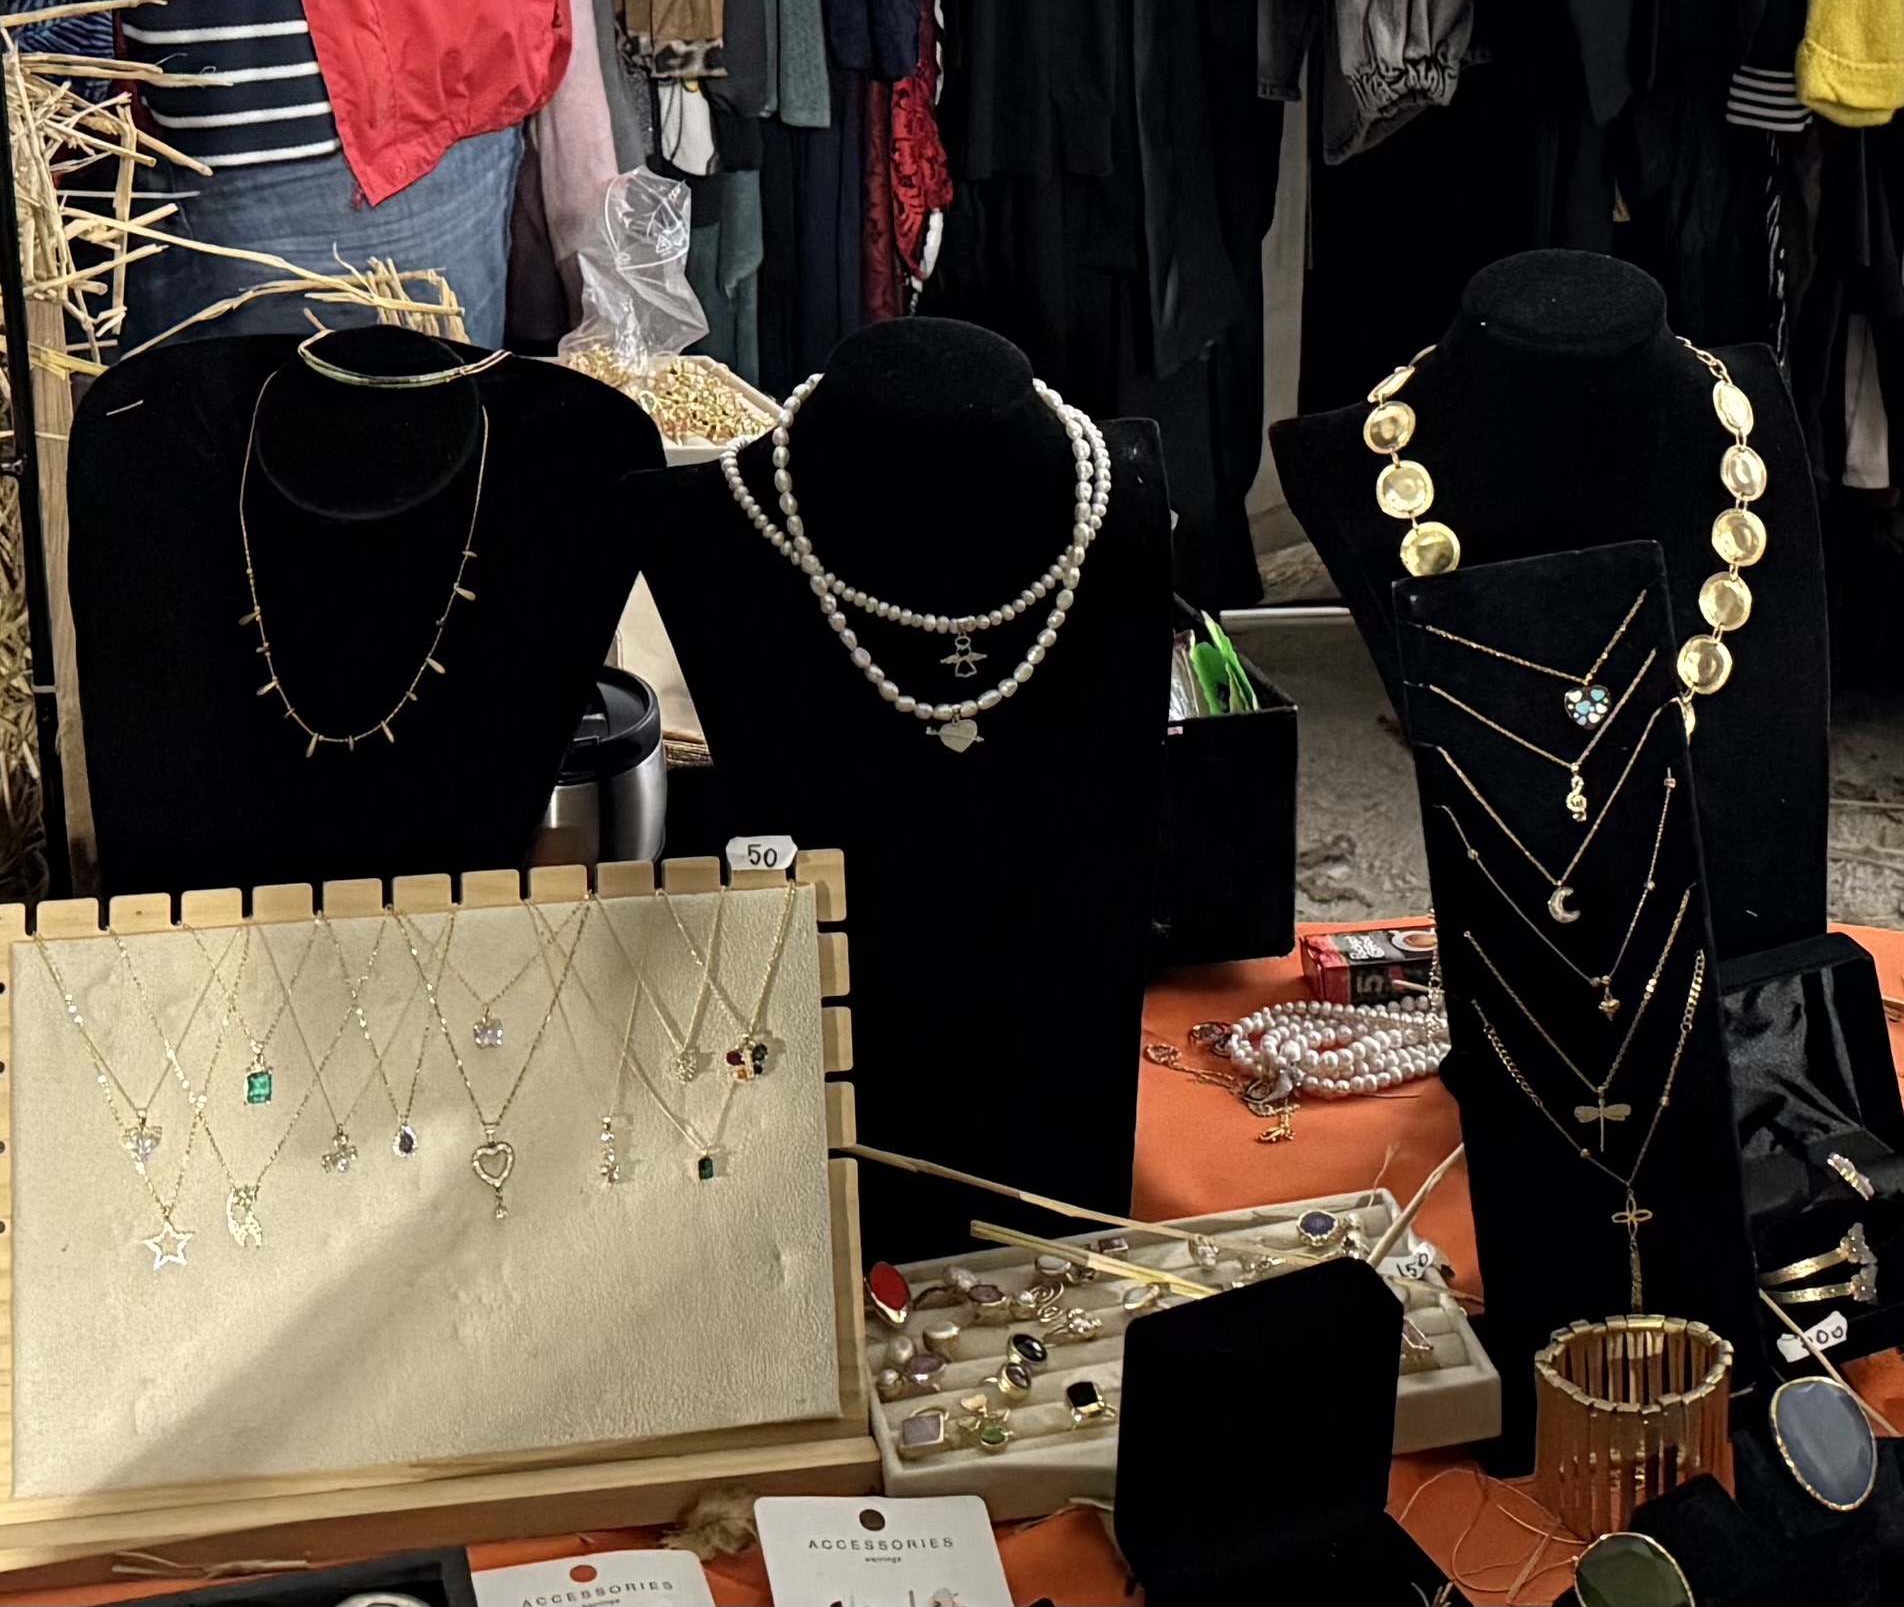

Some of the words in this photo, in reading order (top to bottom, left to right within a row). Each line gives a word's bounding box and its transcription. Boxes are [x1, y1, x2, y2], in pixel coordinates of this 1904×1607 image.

[747, 843, 778, 868] 50
[1807, 1325, 1845, 1345] 00
[808, 1537, 954, 1551] ACCESSORIES
[522, 1580, 674, 1607] ACCESSORIES
